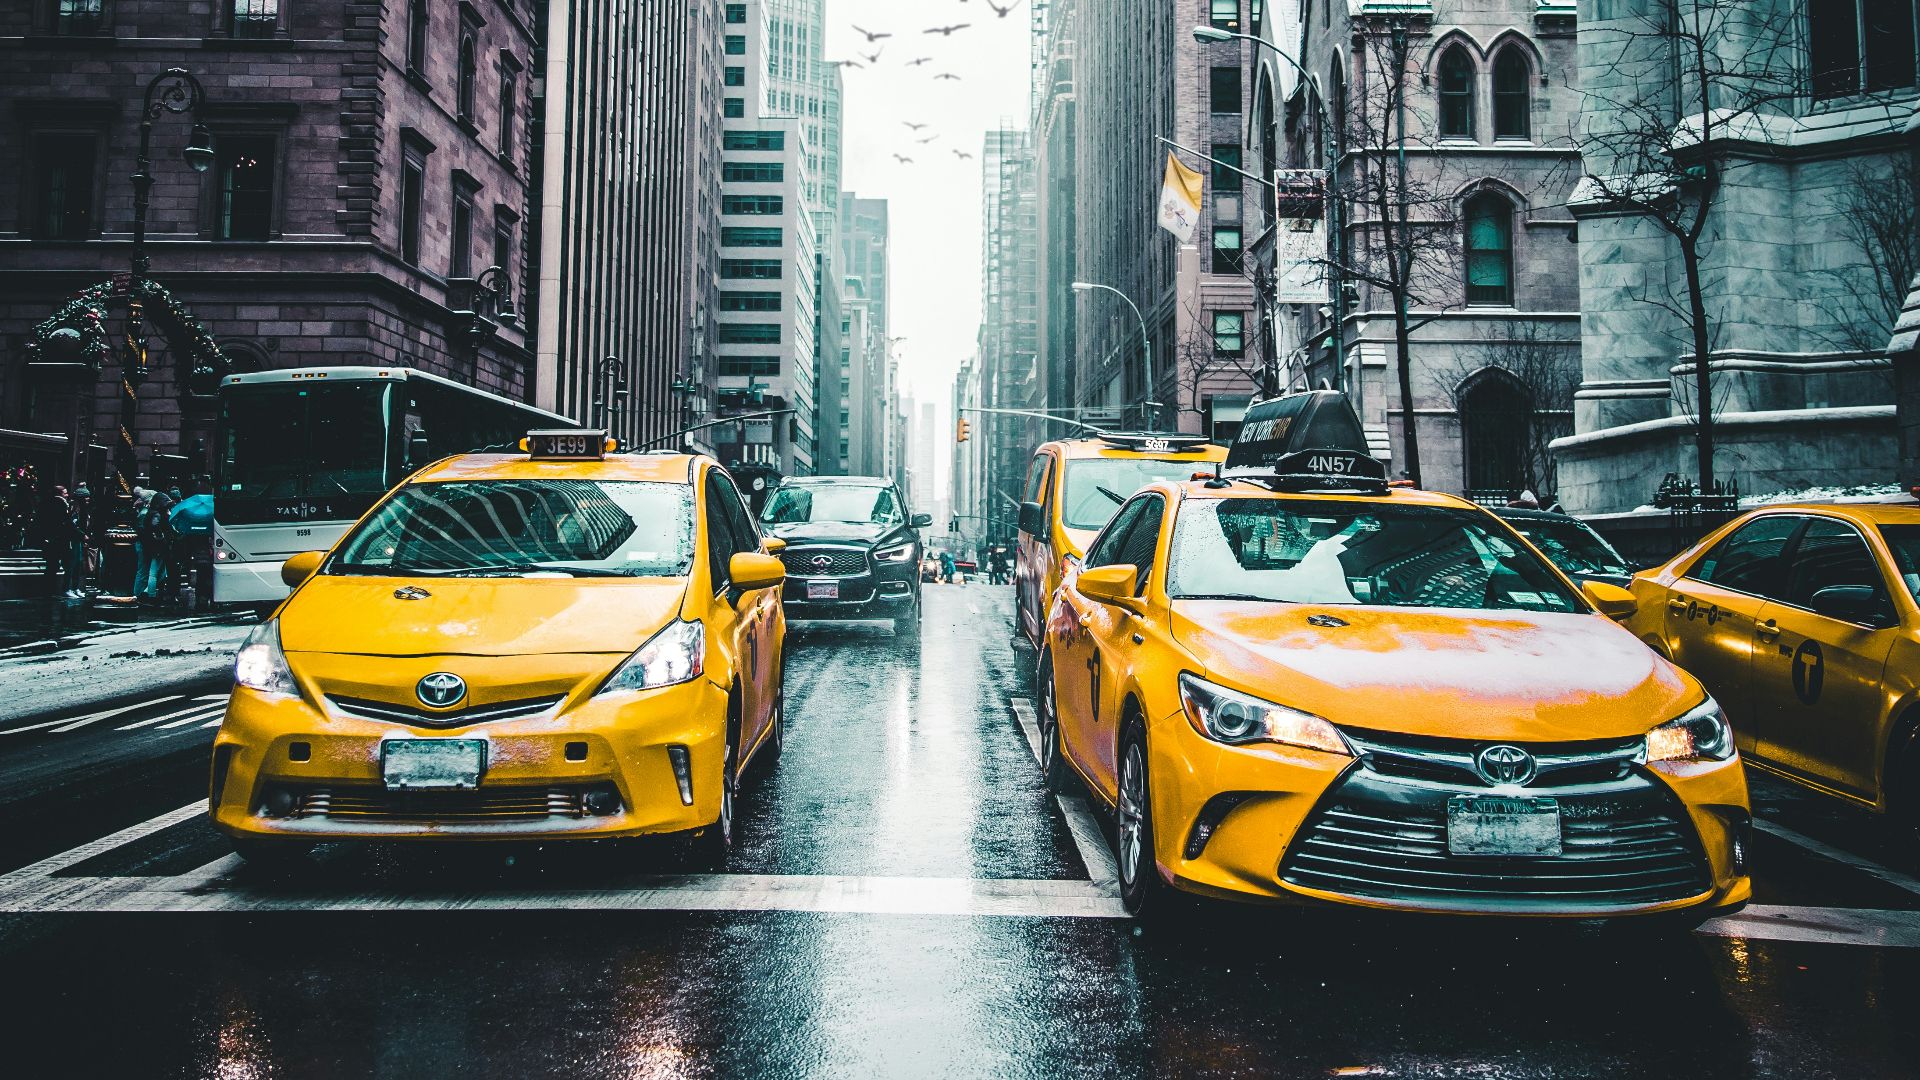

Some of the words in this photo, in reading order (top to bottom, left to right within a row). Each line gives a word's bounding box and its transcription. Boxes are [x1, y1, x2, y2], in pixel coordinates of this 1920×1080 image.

[1237, 422, 1260, 444] NEW
[547, 436, 586, 454] 3E99
[1307, 455, 1356, 473] 4N57
[296, 529, 311, 537] 9598
[1475, 801, 1500, 813] NEW
[1501, 801, 1533, 813] YORK
